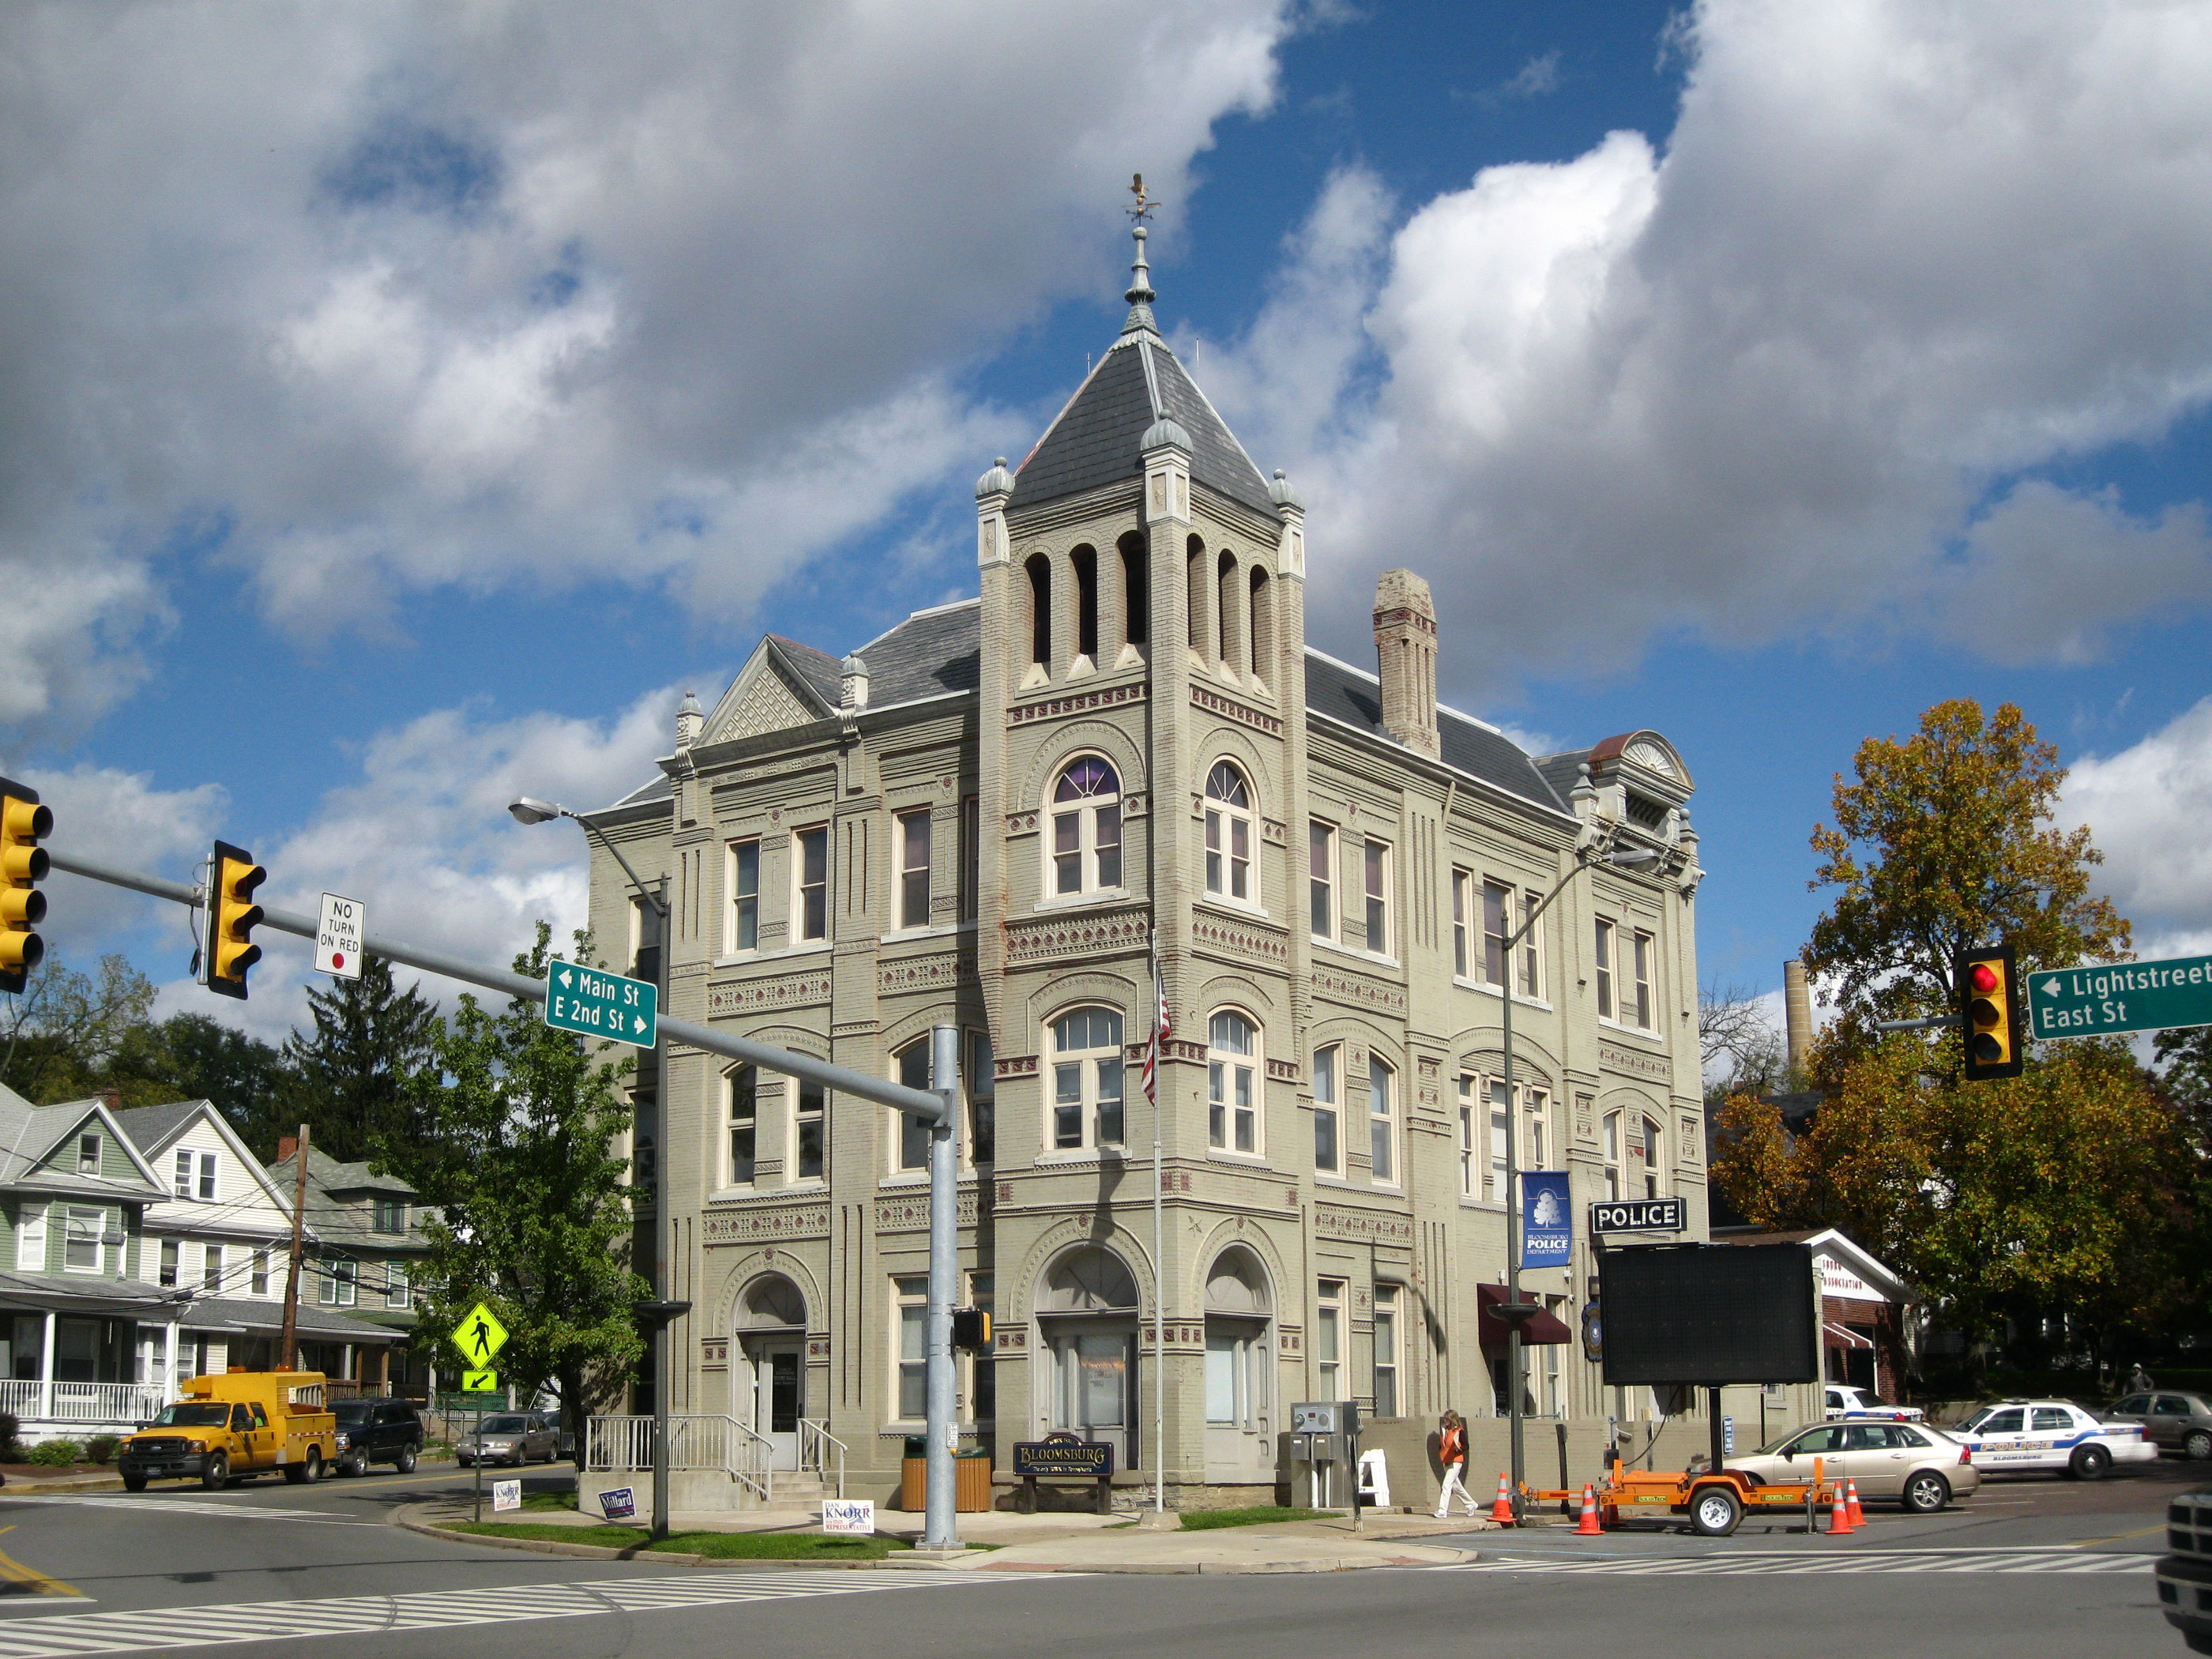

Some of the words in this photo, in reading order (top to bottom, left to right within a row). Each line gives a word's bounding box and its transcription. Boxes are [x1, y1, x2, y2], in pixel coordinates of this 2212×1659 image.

[333, 901, 352, 919] NO
[329, 918, 355, 936] TURN
[321, 933, 334, 947] ON
[340, 938, 359, 953] RED
[579, 972, 615, 1001] Main
[623, 984, 639, 1006] St
[2072, 961, 2212, 999] Lightstreet
[555, 995, 565, 1018] E
[570, 999, 600, 1025] 2nd
[608, 1008, 623, 1031] St
[2042, 1004, 2094, 1029] East
[2102, 1001, 2127, 1023] St
[1598, 1205, 1676, 1229] POLICE
[1527, 1240, 1568, 1249] POLICE
[1823, 1277, 1862, 1290] ASSOCIATION
[1980, 1441, 2053, 1451] POLICE
[1020, 1447, 1104, 1464] BLOOMSBURG
[495, 1486, 520, 1499] KNORR
[601, 1492, 632, 1510] Millard
[826, 1507, 871, 1519] KNORR
